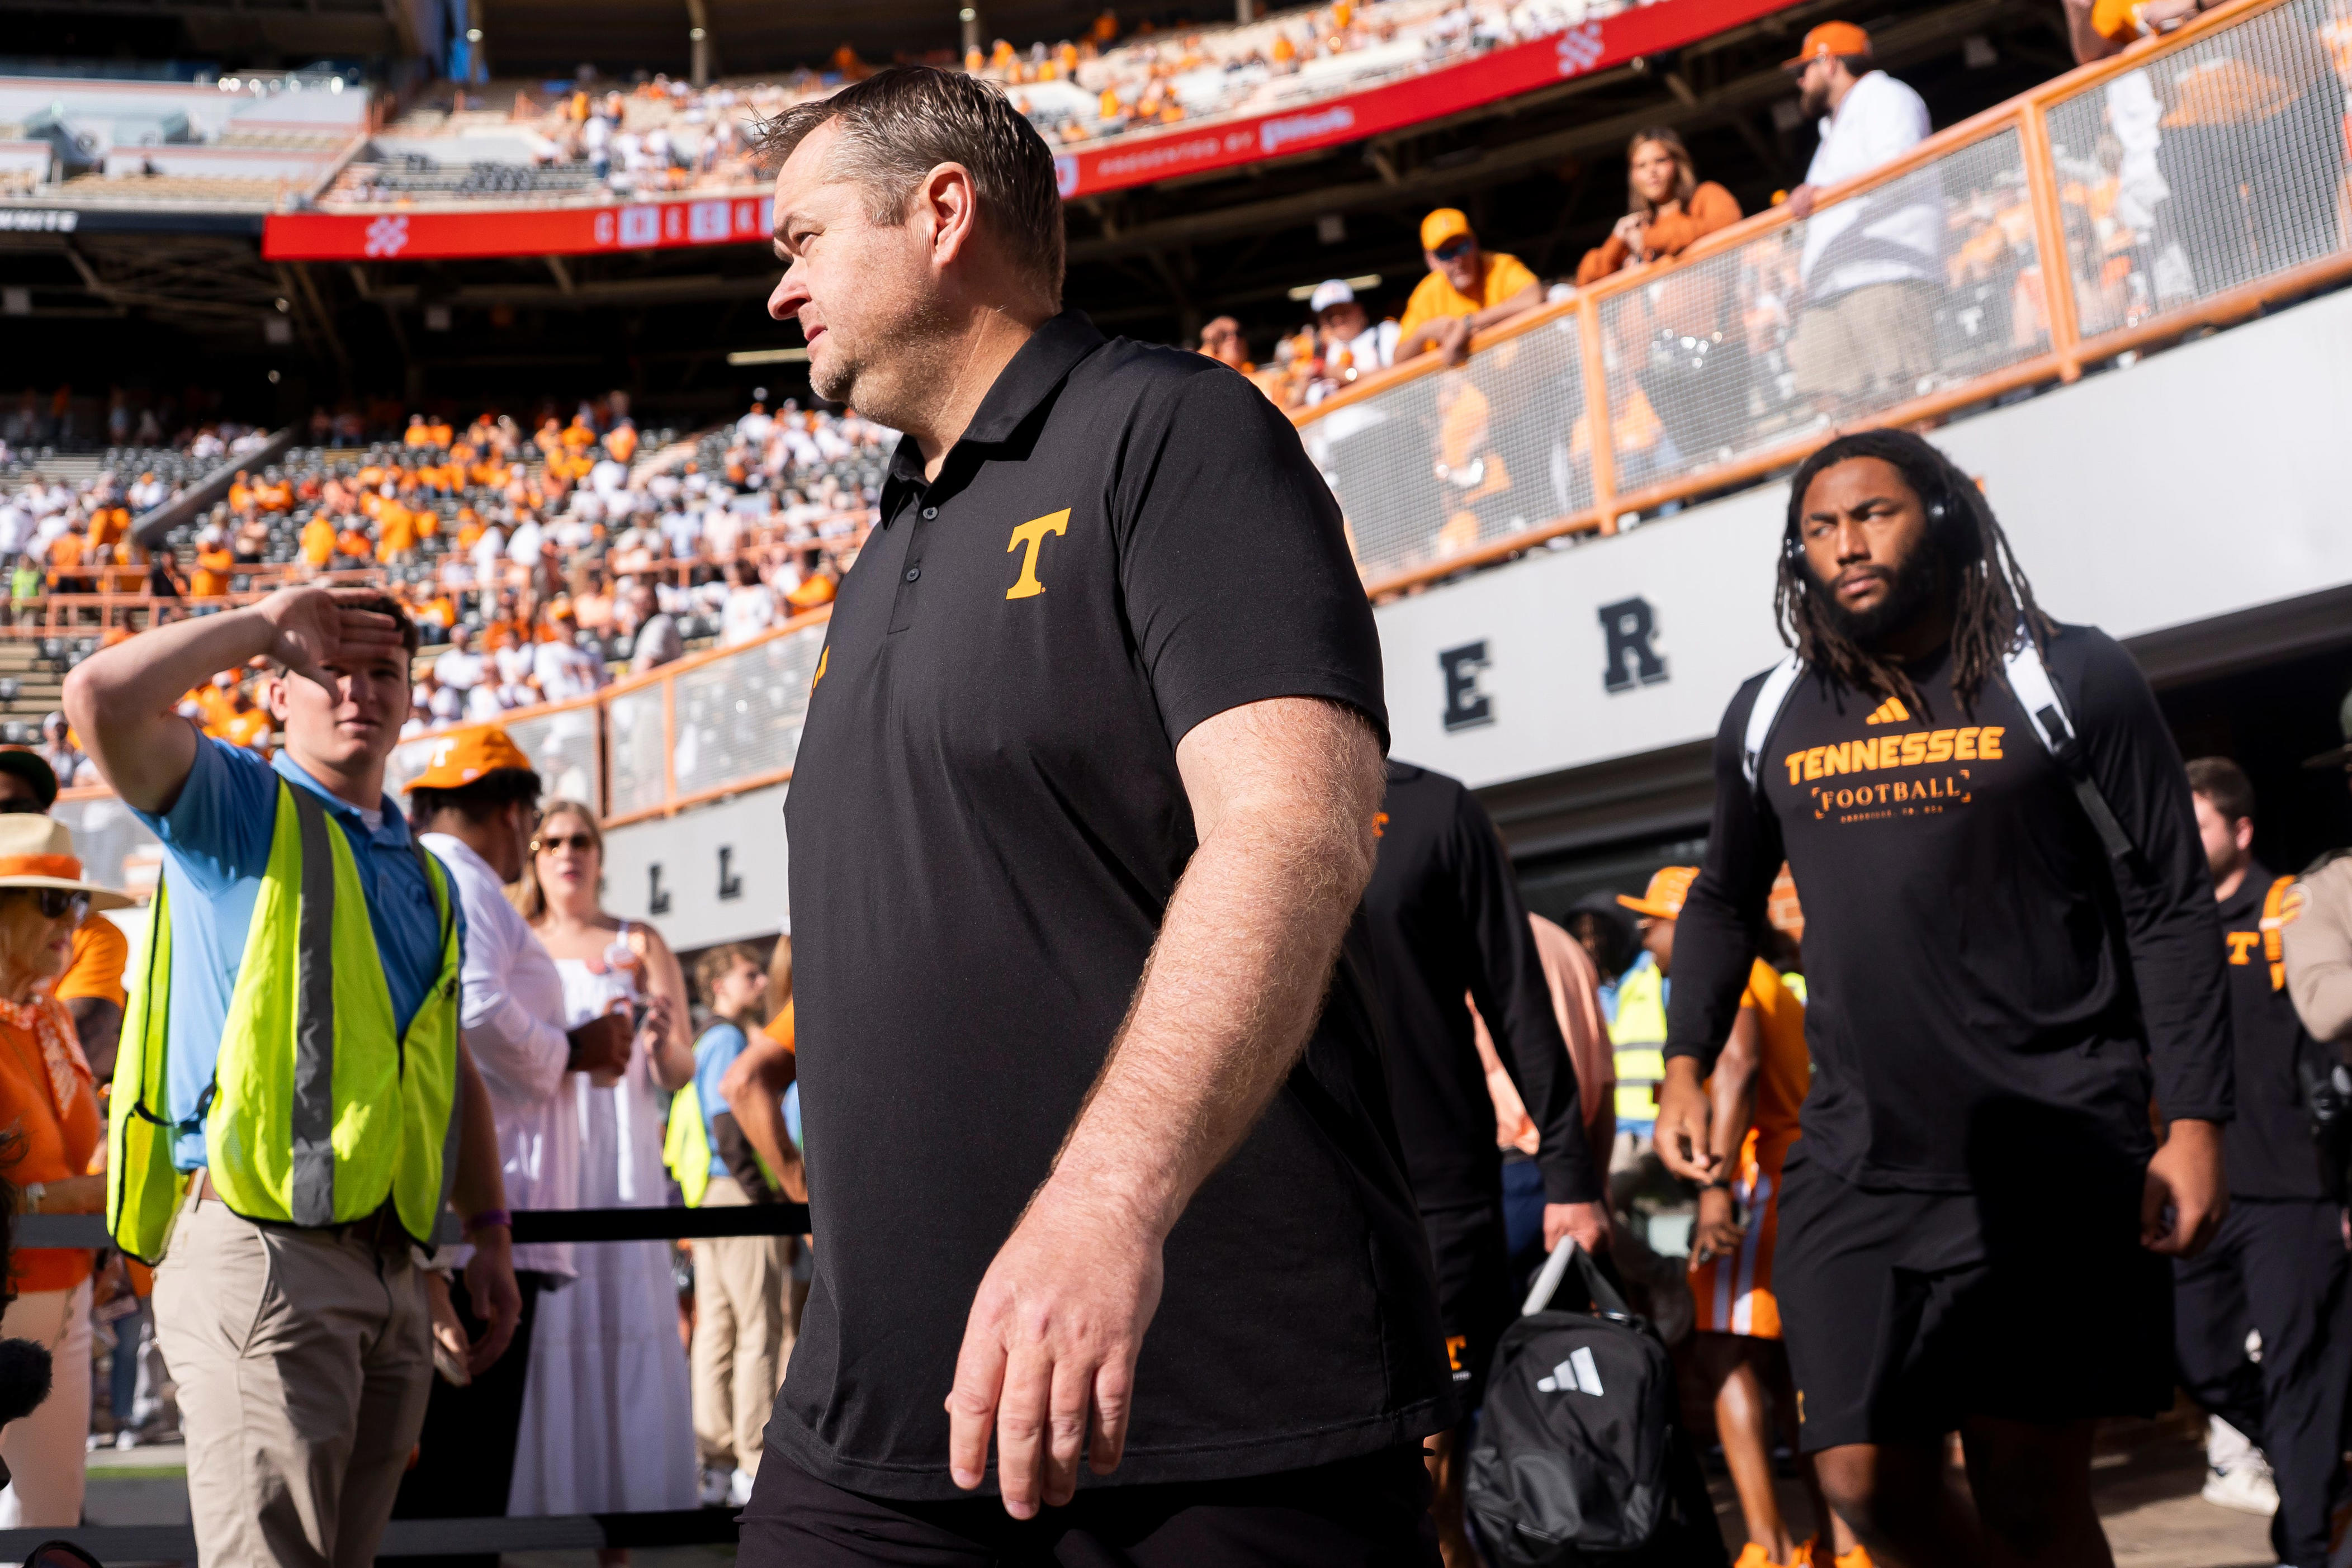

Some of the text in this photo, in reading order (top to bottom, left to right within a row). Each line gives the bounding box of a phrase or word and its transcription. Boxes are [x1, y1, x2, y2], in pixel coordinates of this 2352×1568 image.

[1006, 506, 1072, 600] T
[1785, 726, 2006, 786] TENNESSEE
[1820, 776, 1961, 812] FOOTBALL
[2226, 931, 2260, 965] T
